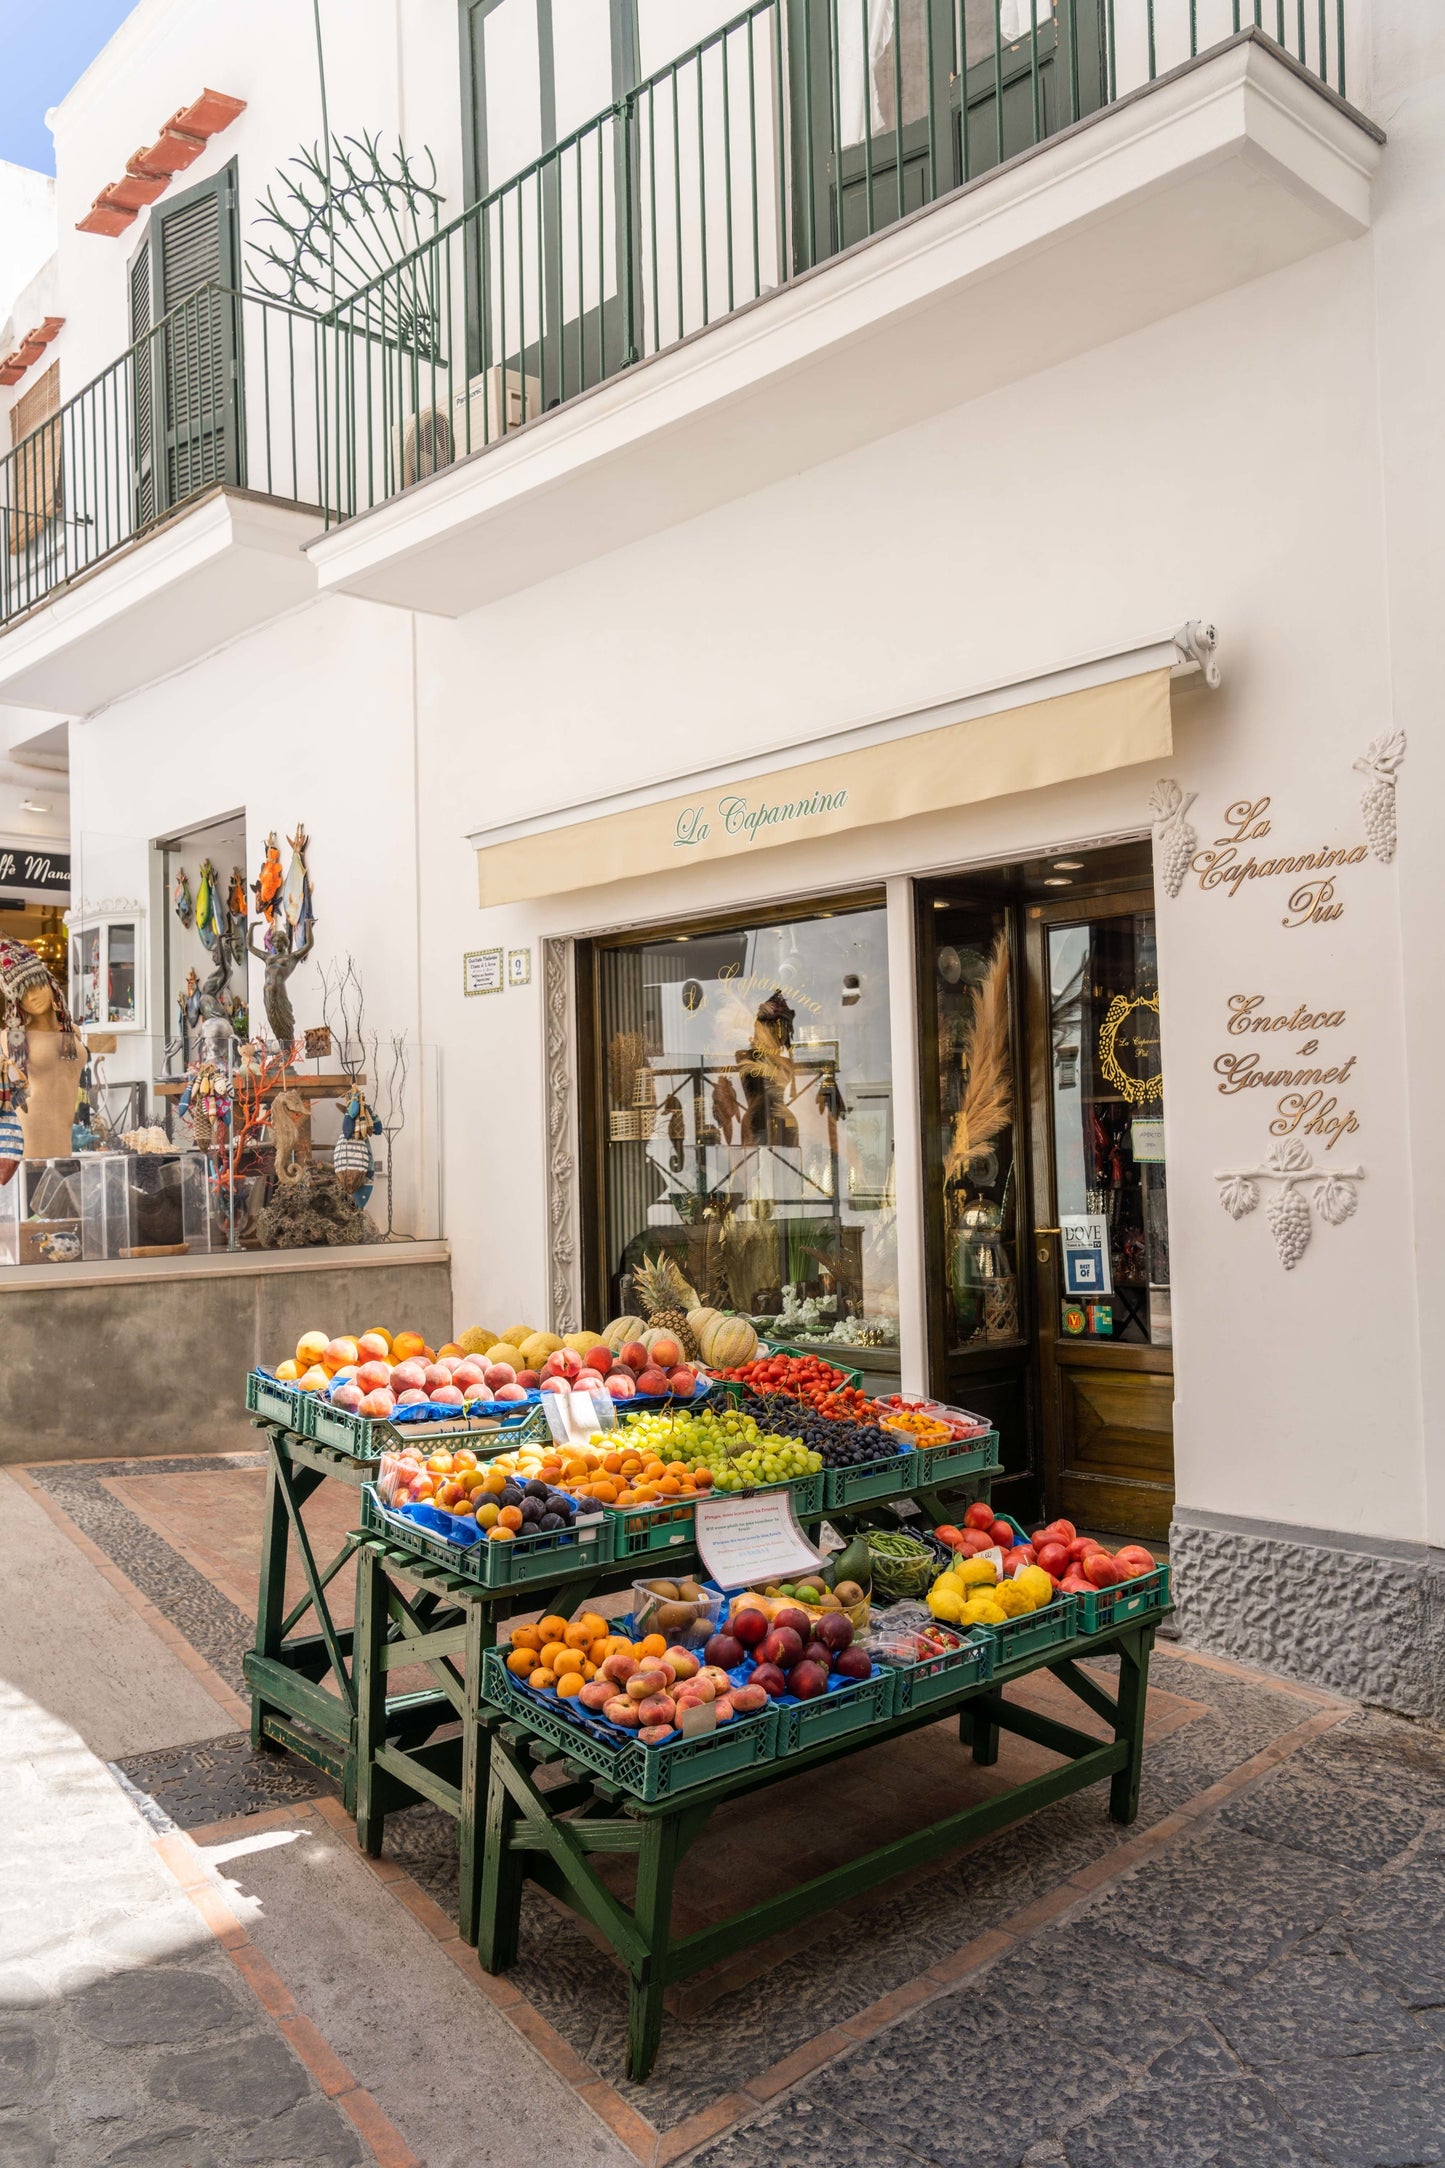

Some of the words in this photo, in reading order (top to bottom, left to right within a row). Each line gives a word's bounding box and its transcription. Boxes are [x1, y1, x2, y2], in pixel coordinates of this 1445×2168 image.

[456, 387, 482, 406] Pansonic
[673, 806, 710, 846] La
[718, 790, 848, 842] Capannina
[1213, 797, 1271, 846] La
[1191, 845, 1368, 897] Capannina
[682, 985, 707, 1022] La
[718, 962, 822, 1015] Capannina
[1227, 994, 1346, 1035] Enoteca
[1296, 1039, 1319, 1056] e
[1213, 1053, 1357, 1095] Gourmet
[1269, 1090, 1360, 1151] Shop
[1065, 1225, 1102, 1241] DOVE
[1080, 1270, 1090, 1278] OF
